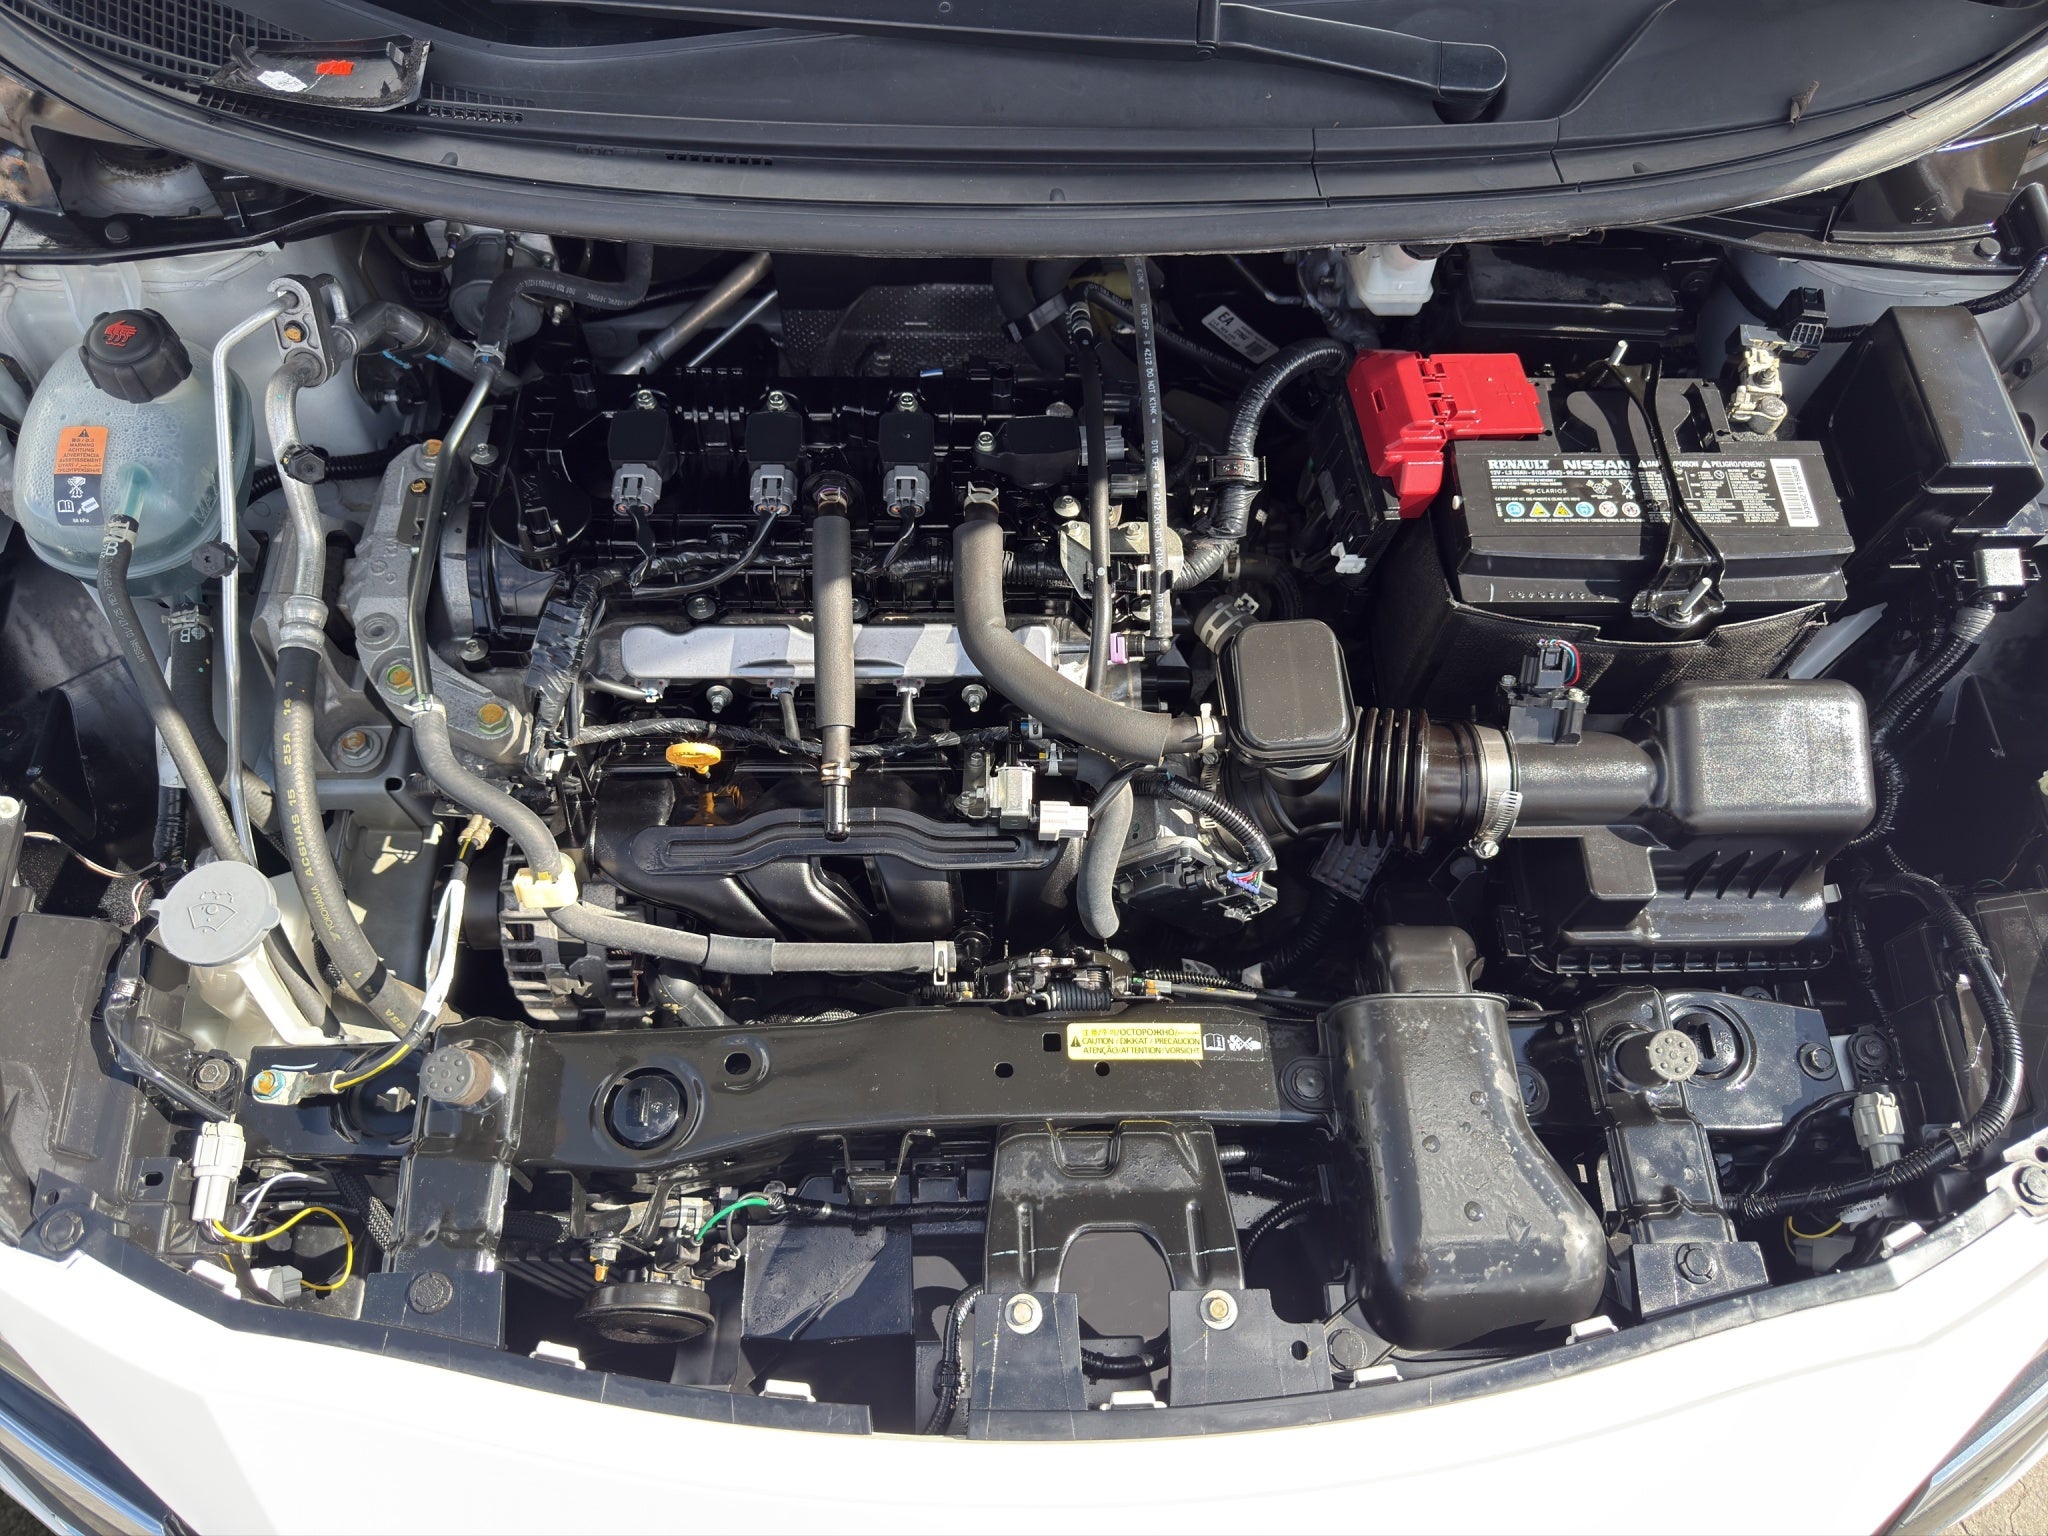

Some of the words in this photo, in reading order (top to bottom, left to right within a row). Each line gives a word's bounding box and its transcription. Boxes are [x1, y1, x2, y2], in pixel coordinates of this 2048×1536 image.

[1218, 311, 1235, 326] EA
[1149, 396, 1158, 415] KINK
[1488, 460, 1550, 470] RENAULT
[1563, 460, 1631, 470] NISSAN
[106, 541, 119, 556] B
[181, 628, 191, 642] B
[283, 698, 293, 716] 14
[283, 731, 292, 765] 25A
[288, 788, 297, 807] 15
[310, 884, 335, 933] YOKOHAMA
[1082, 1037, 1114, 1045] CAUTION
